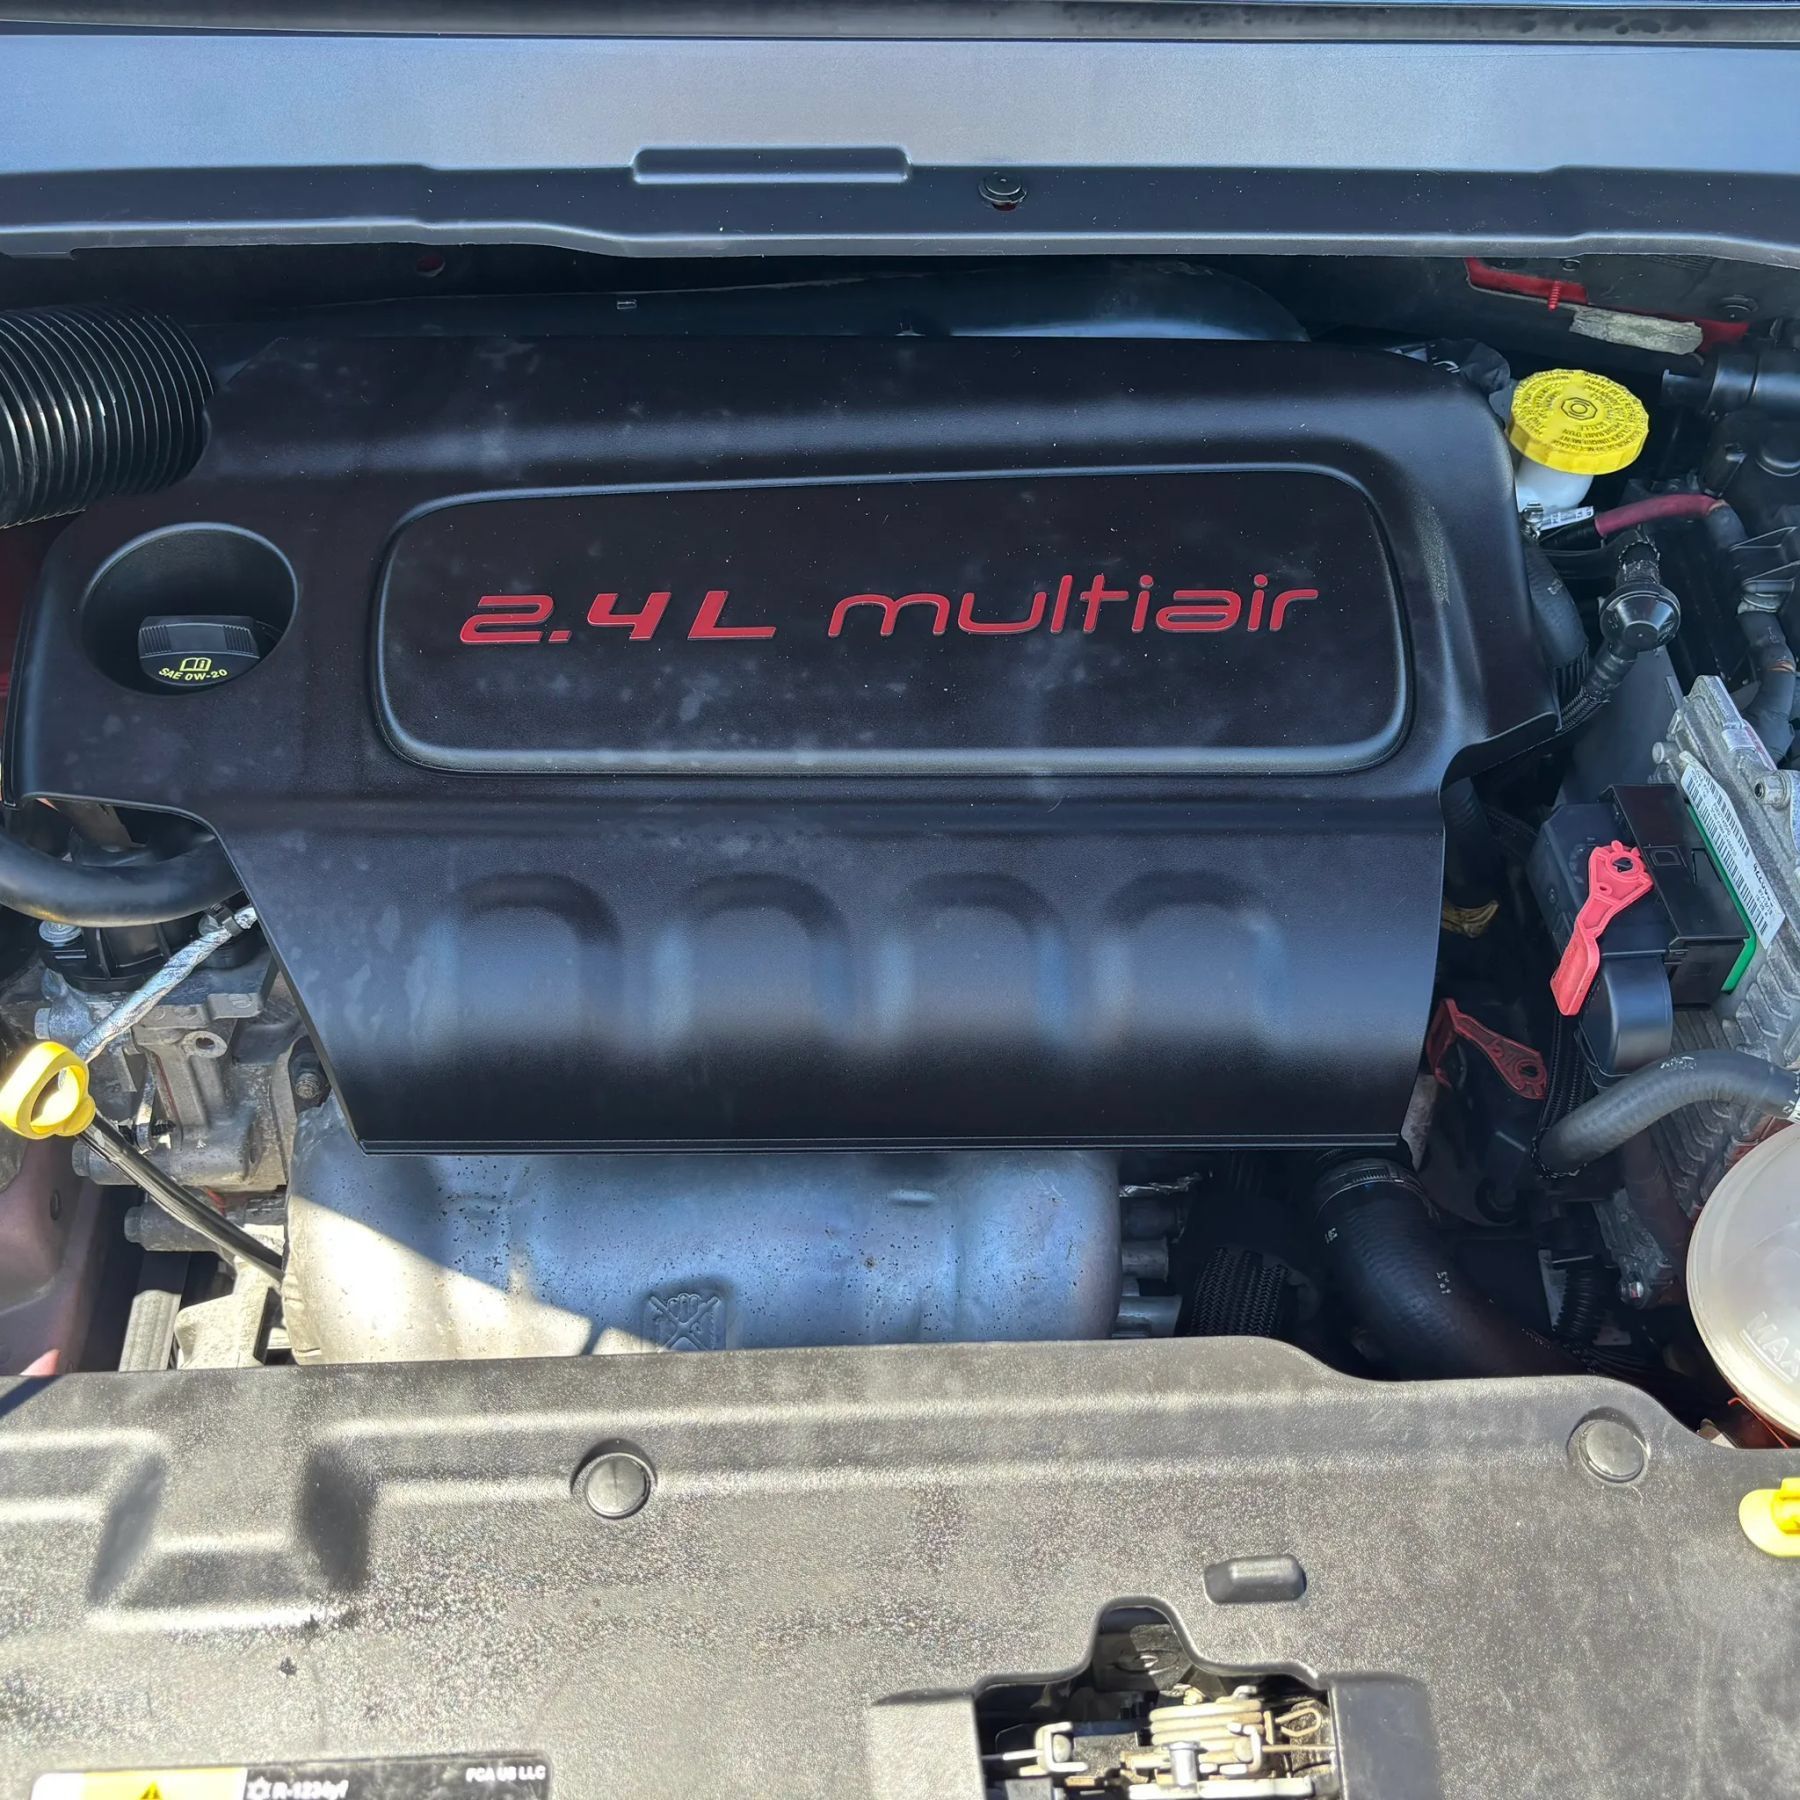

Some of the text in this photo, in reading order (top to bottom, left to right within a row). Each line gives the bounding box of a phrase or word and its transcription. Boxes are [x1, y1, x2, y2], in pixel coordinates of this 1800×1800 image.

[828, 574, 1319, 637] multiair
[158, 667, 183, 680] SAE
[518, 1764, 546, 1781] LLC
